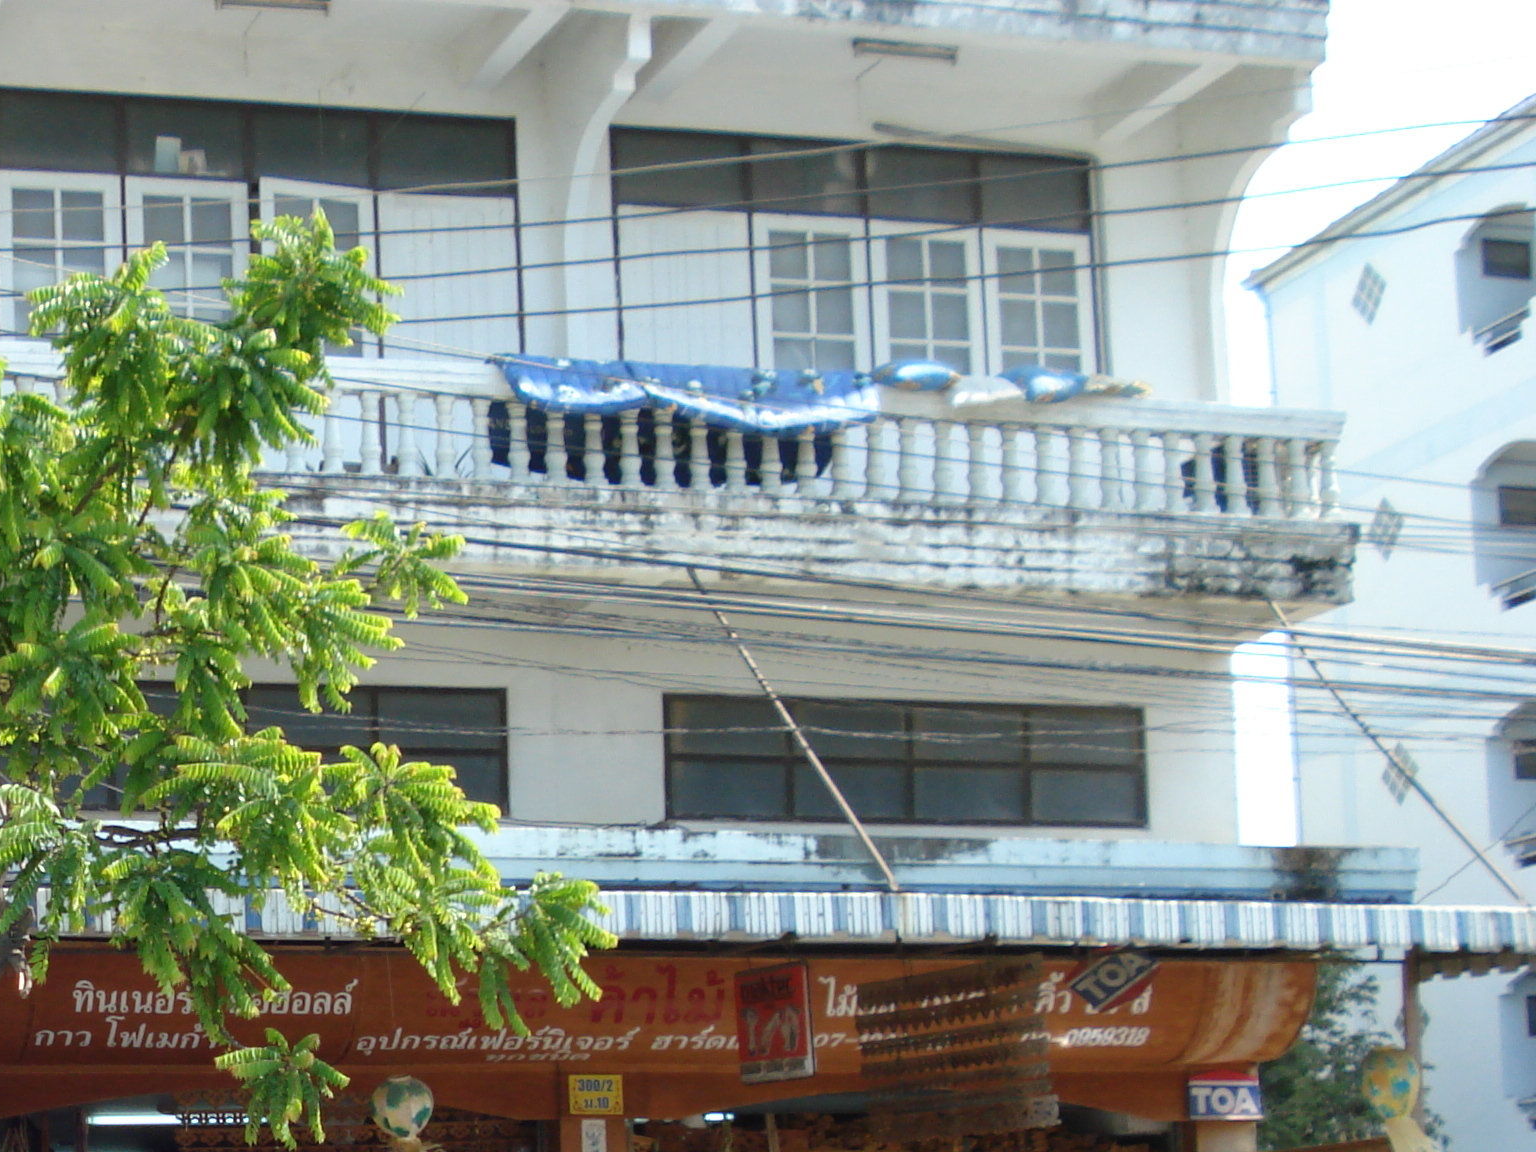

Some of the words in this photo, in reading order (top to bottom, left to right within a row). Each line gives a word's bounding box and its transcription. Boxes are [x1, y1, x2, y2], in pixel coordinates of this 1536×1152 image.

[1076, 953, 1151, 1000] TOA
[34, 1029, 92, 1048] กาว
[578, 1079, 614, 1093] 300/2
[1191, 1086, 1260, 1115] TOA
